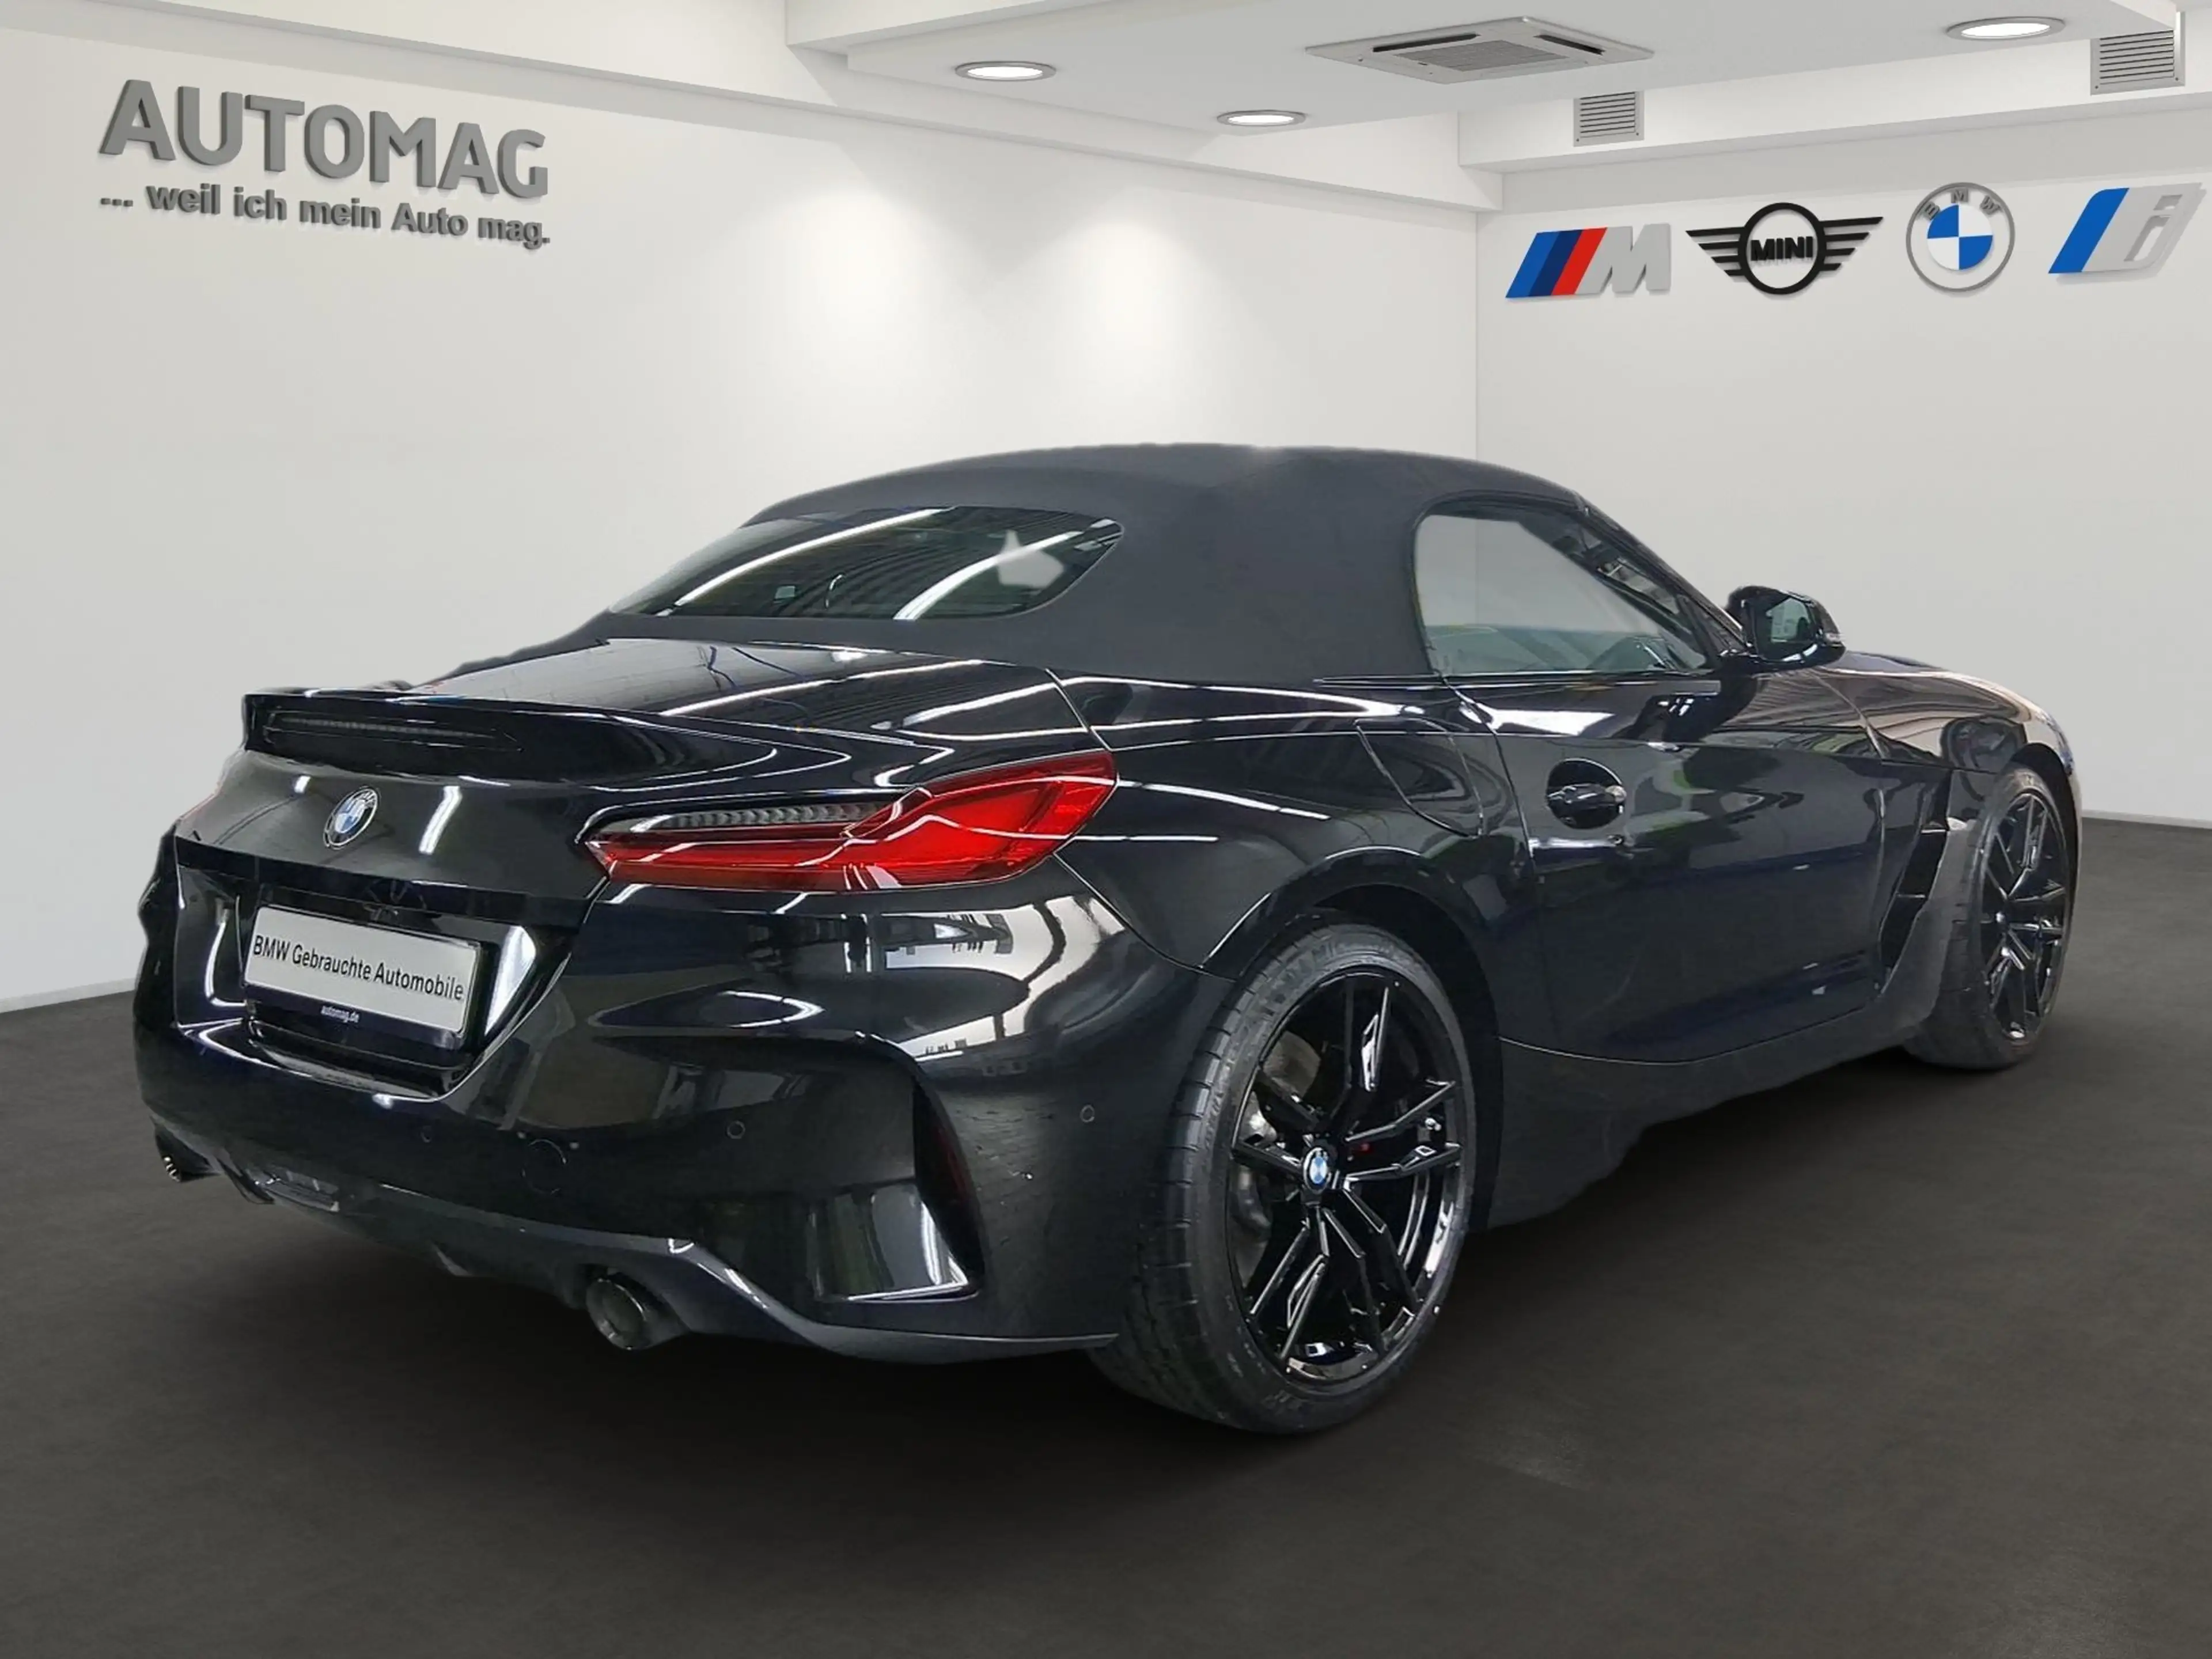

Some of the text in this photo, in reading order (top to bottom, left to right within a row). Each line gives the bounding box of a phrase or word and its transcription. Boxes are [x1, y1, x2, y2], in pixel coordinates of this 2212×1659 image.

[99, 79, 548, 198] AUTOMAG
[146, 183, 221, 215] weil
[234, 186, 287, 220] ich
[300, 198, 381, 229] mein
[391, 202, 468, 236] Auto
[478, 216, 551, 249] mag.
[1923, 188, 2002, 221] BMW
[1751, 236, 1813, 262] MINI
[253, 935, 464, 1001] BMW Gebrauchte Automobile
